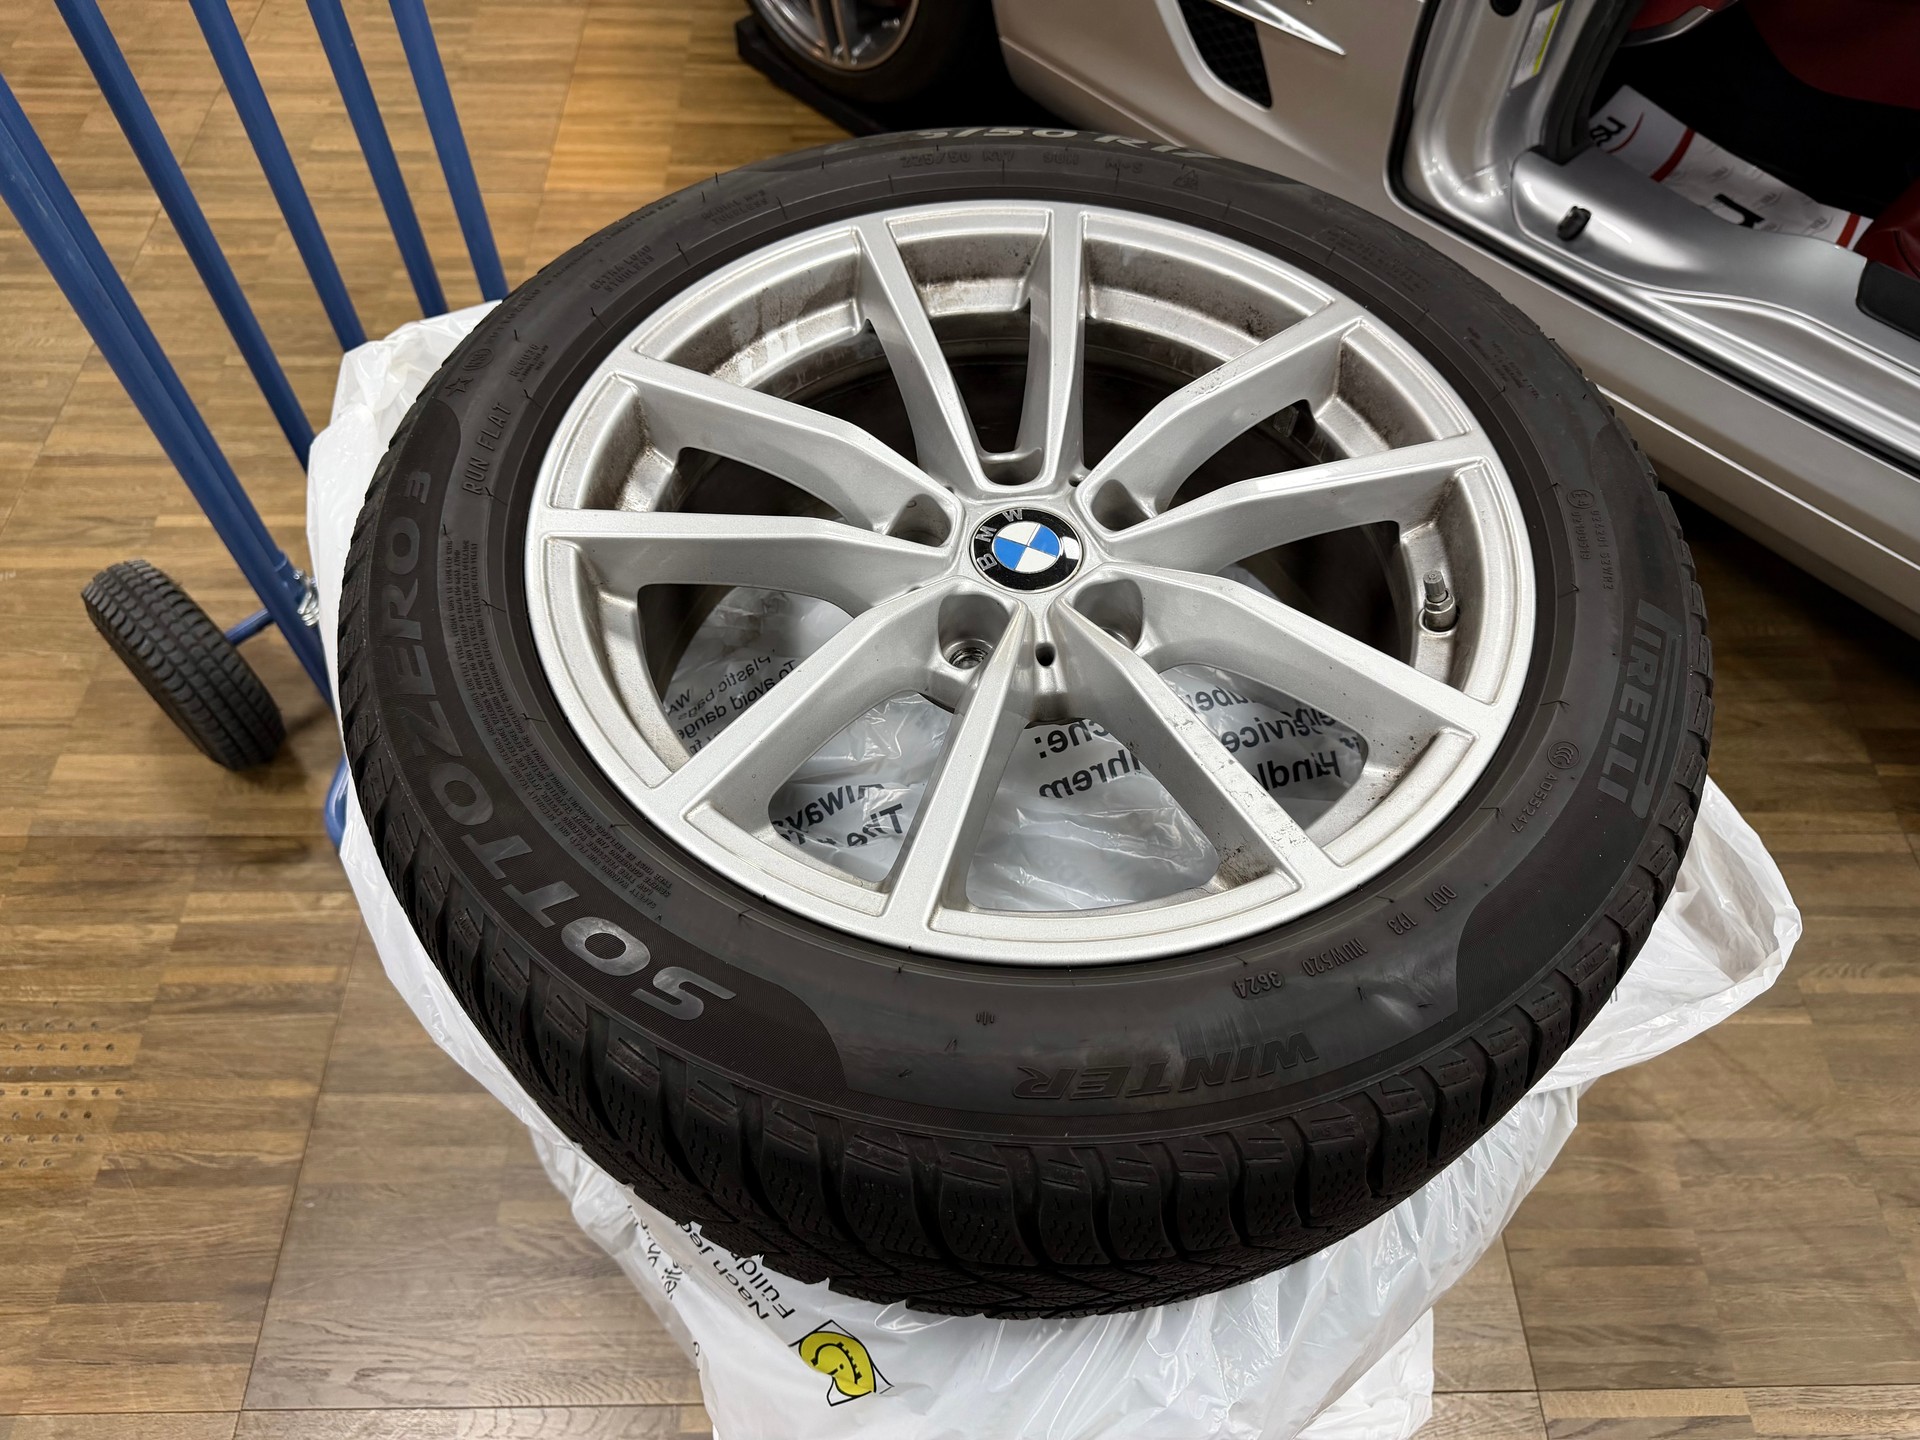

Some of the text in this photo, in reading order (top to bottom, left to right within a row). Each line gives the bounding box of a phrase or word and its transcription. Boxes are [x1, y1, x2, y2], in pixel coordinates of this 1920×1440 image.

[461, 402, 513, 496] RUN FLAT
[404, 470, 432, 505] 3
[974, 508, 1023, 571] BMW
[1598, 601, 1682, 819] PIRELLI
[385, 516, 737, 1021] SOTTOZERO
[1511, 770, 1559, 834] A055247
[1424, 884, 1458, 912] DOT
[1234, 969, 1282, 998] 3624
[1302, 937, 1369, 976] NUW520
[1012, 1031, 1320, 1100] WINTER
[712, 1259, 770, 1320] Nach
